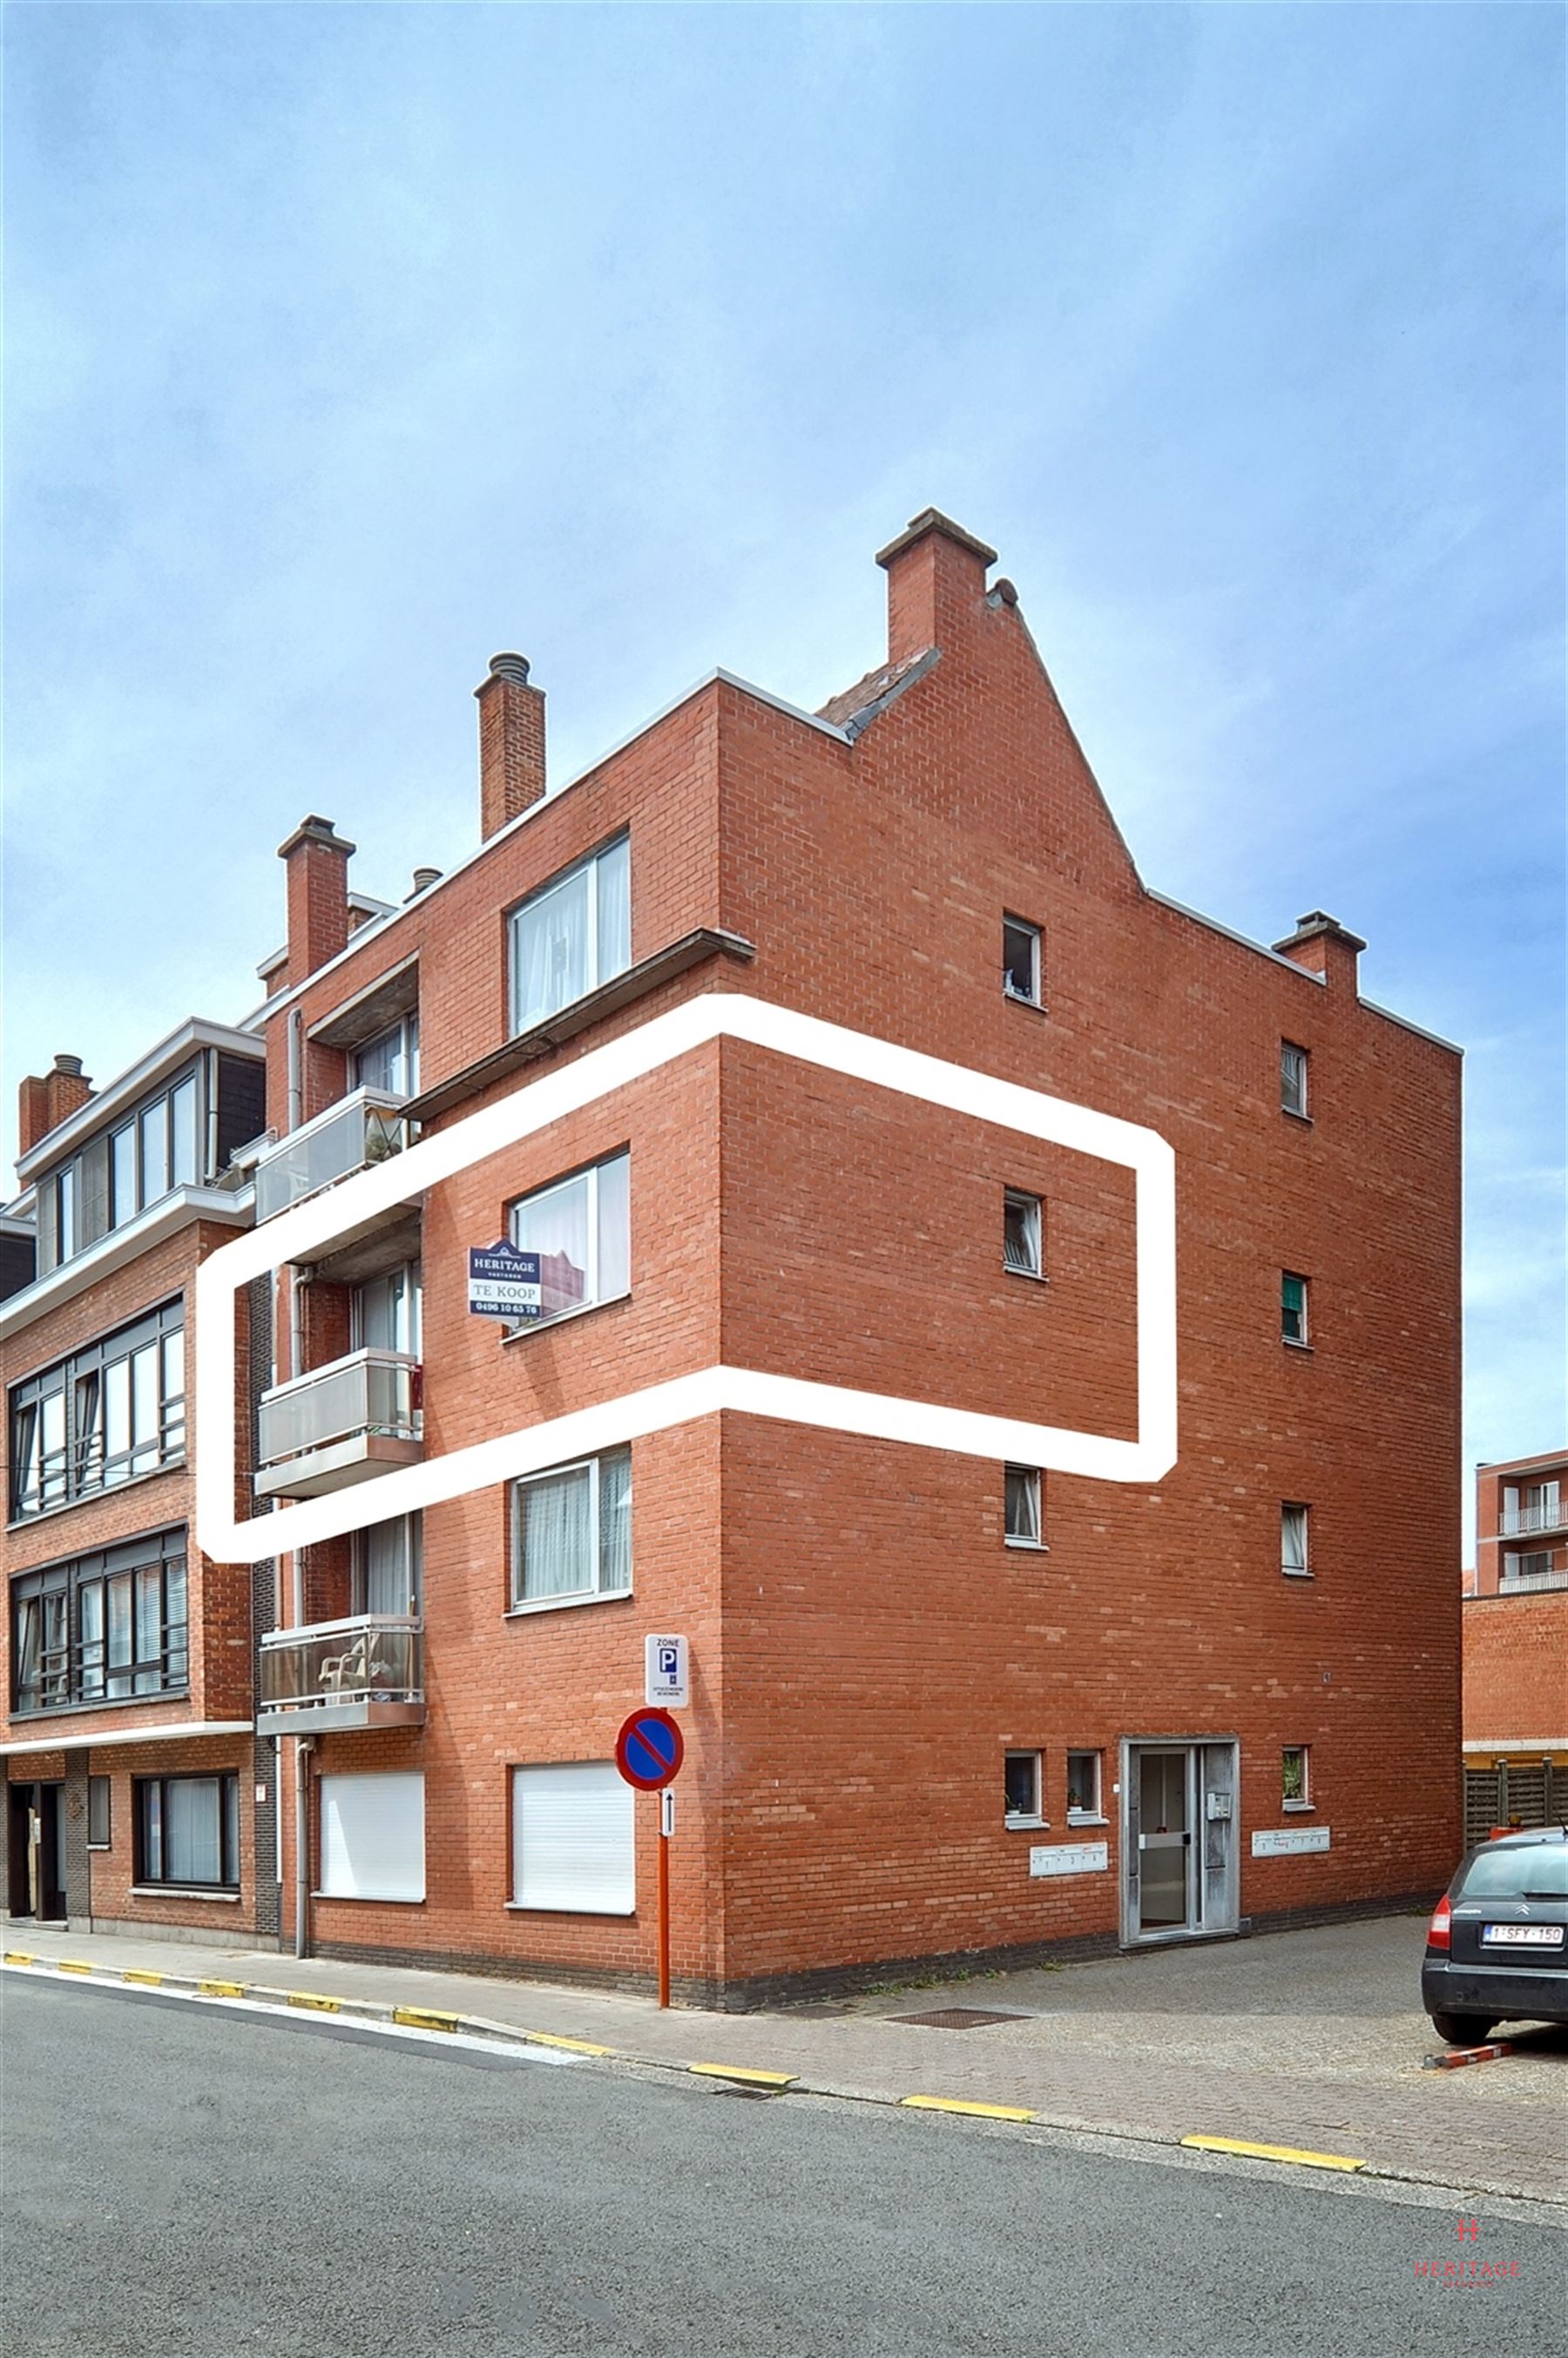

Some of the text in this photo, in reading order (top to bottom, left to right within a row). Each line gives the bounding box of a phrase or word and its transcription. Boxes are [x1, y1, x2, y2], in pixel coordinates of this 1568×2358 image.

[474, 1258, 535, 1273] HERITAGE
[473, 1284, 536, 1299] TE KOOP
[501, 1304, 511, 1313] 10
[657, 1638, 679, 1647] ZONE
[662, 1650, 675, 1671] P
